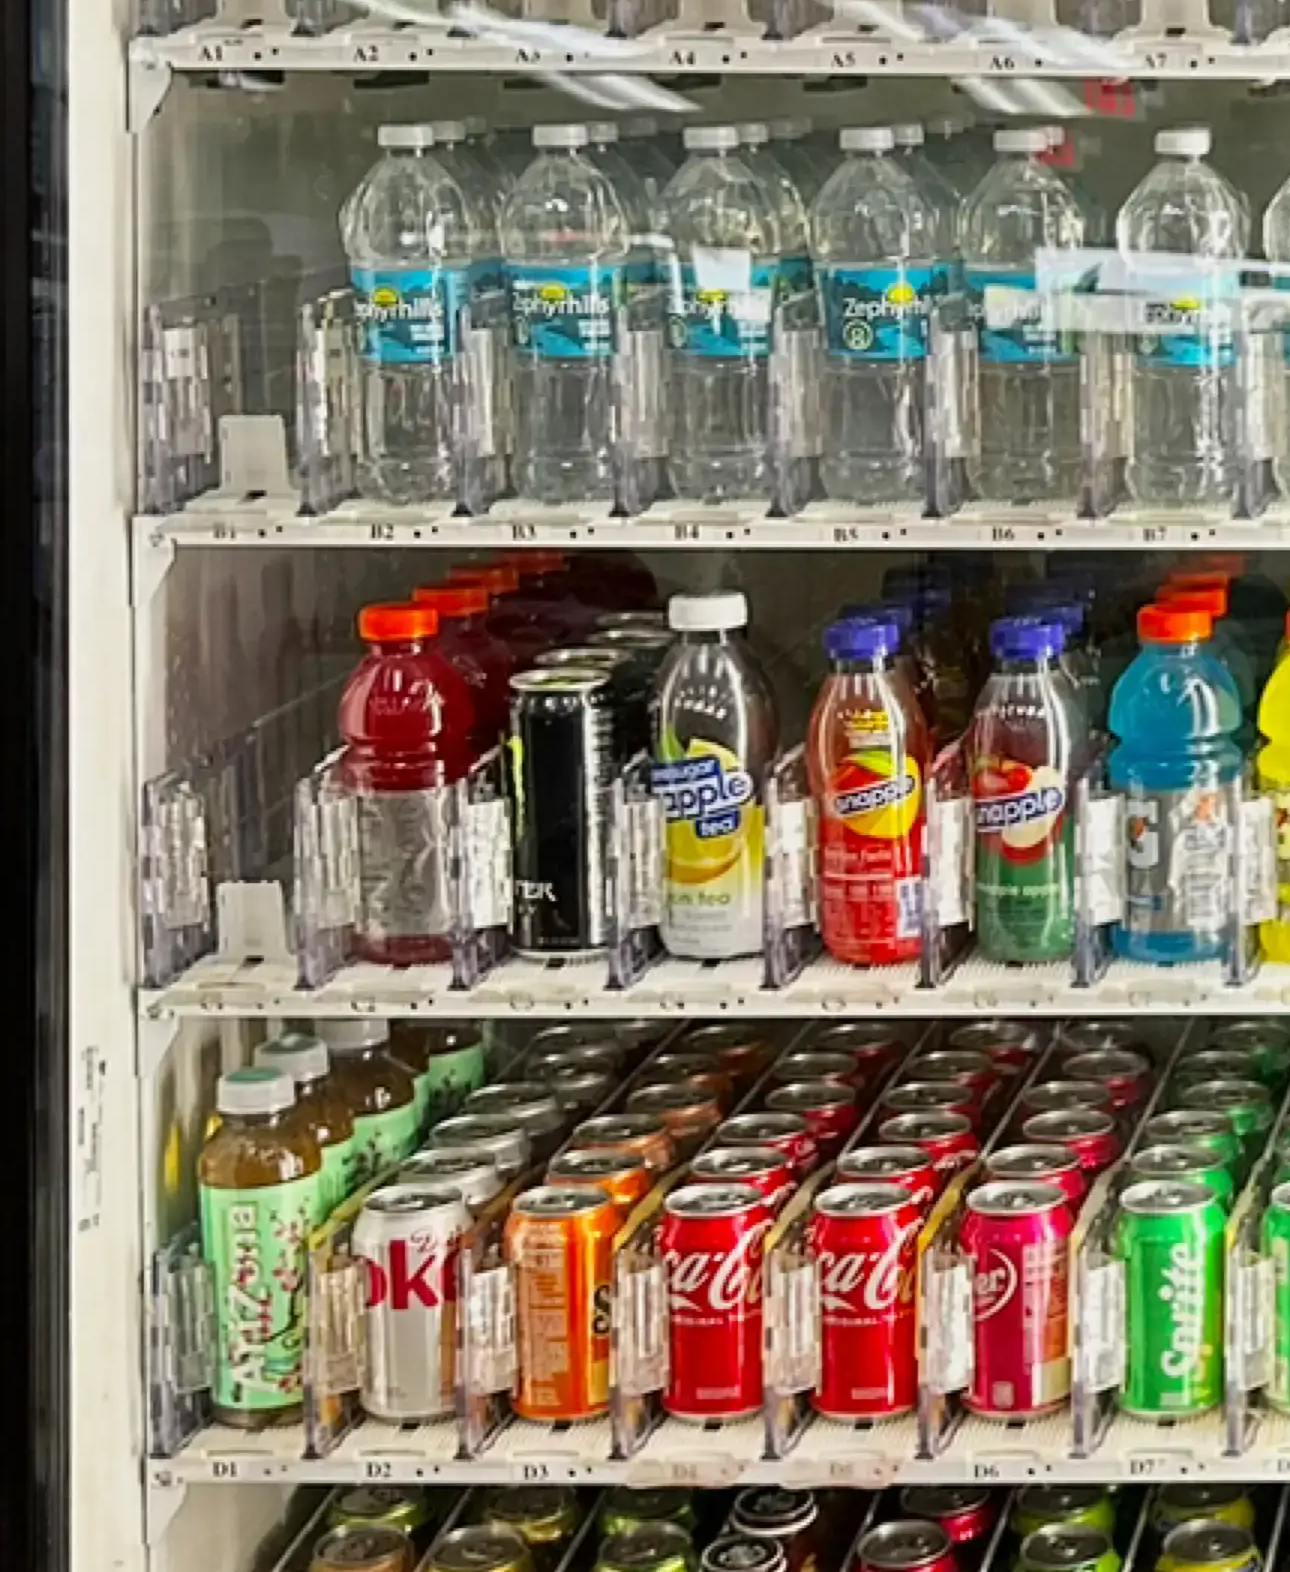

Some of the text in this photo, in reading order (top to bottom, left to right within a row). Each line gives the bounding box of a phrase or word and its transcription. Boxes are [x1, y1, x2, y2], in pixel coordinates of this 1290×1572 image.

[975, 786, 1064, 826] napple
[1159, 1241, 1208, 1379] Sprite
[366, 1461, 392, 1478] D2
[523, 1462, 549, 1480] D3
